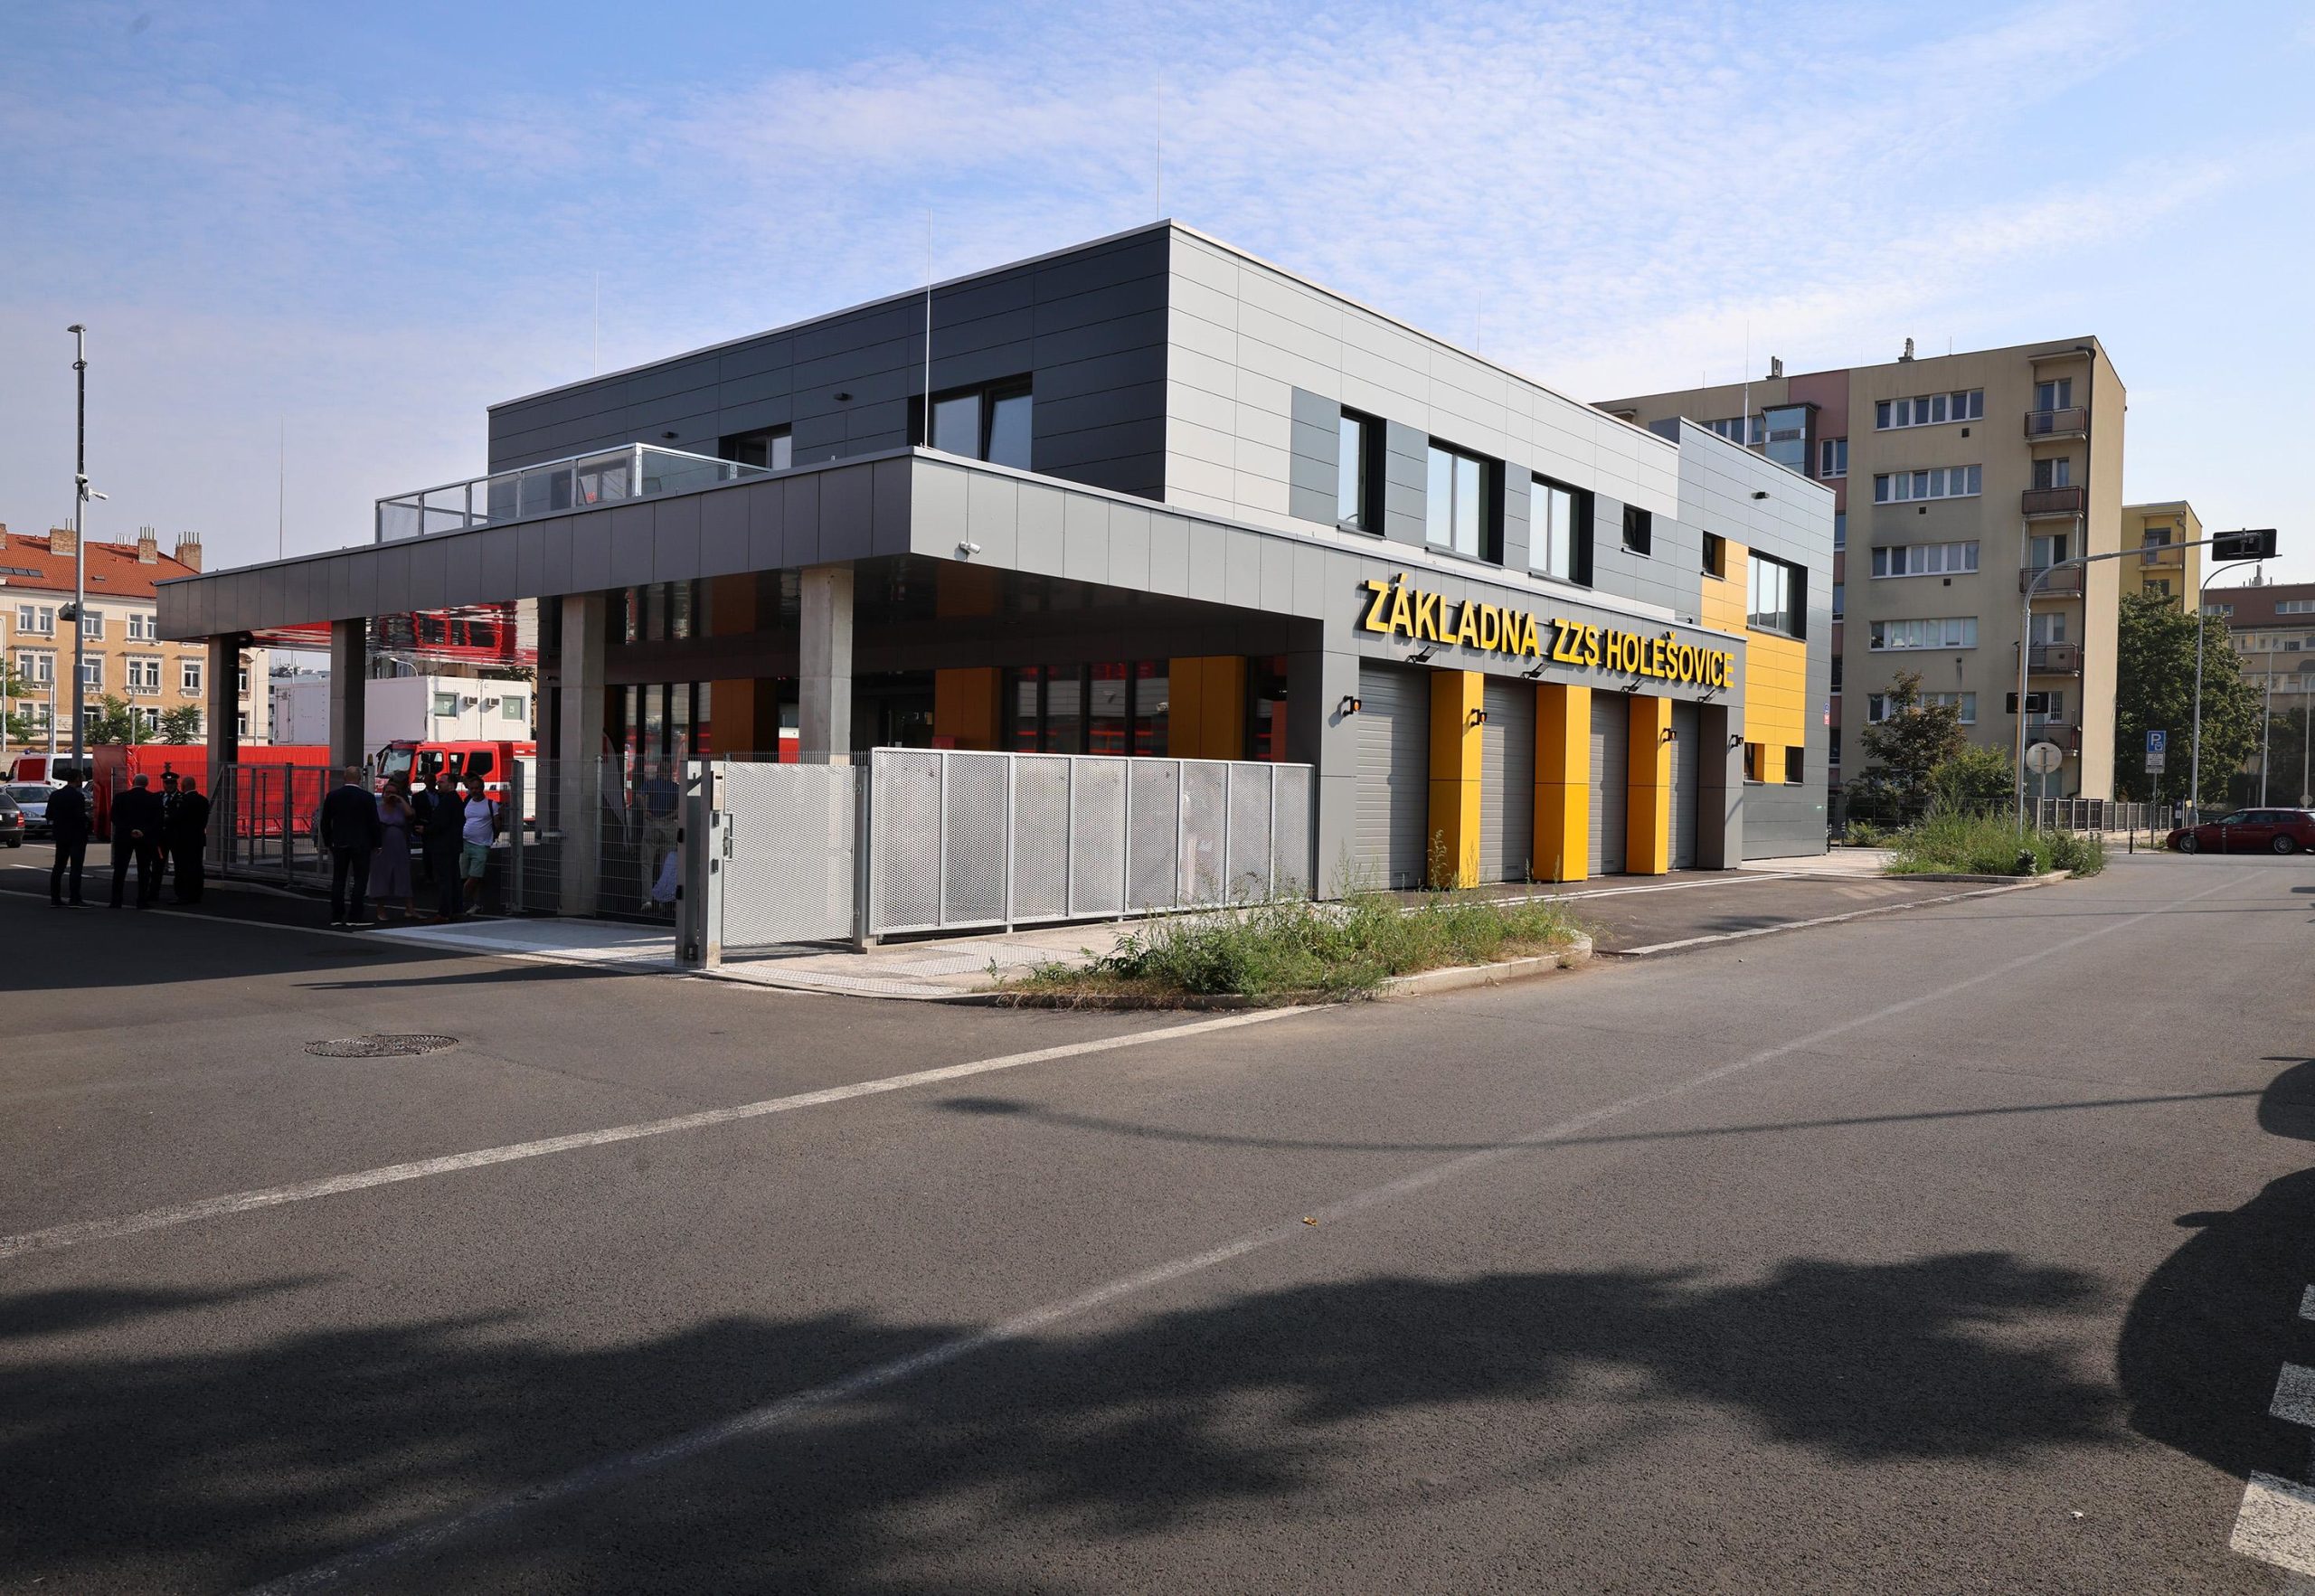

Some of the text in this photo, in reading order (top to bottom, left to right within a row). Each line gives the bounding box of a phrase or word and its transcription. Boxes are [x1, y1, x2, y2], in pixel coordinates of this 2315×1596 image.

[1365, 572, 1735, 688] ZÁKLADNA ZZS HOLEŠOVICE
[2150, 732, 2162, 746] P
